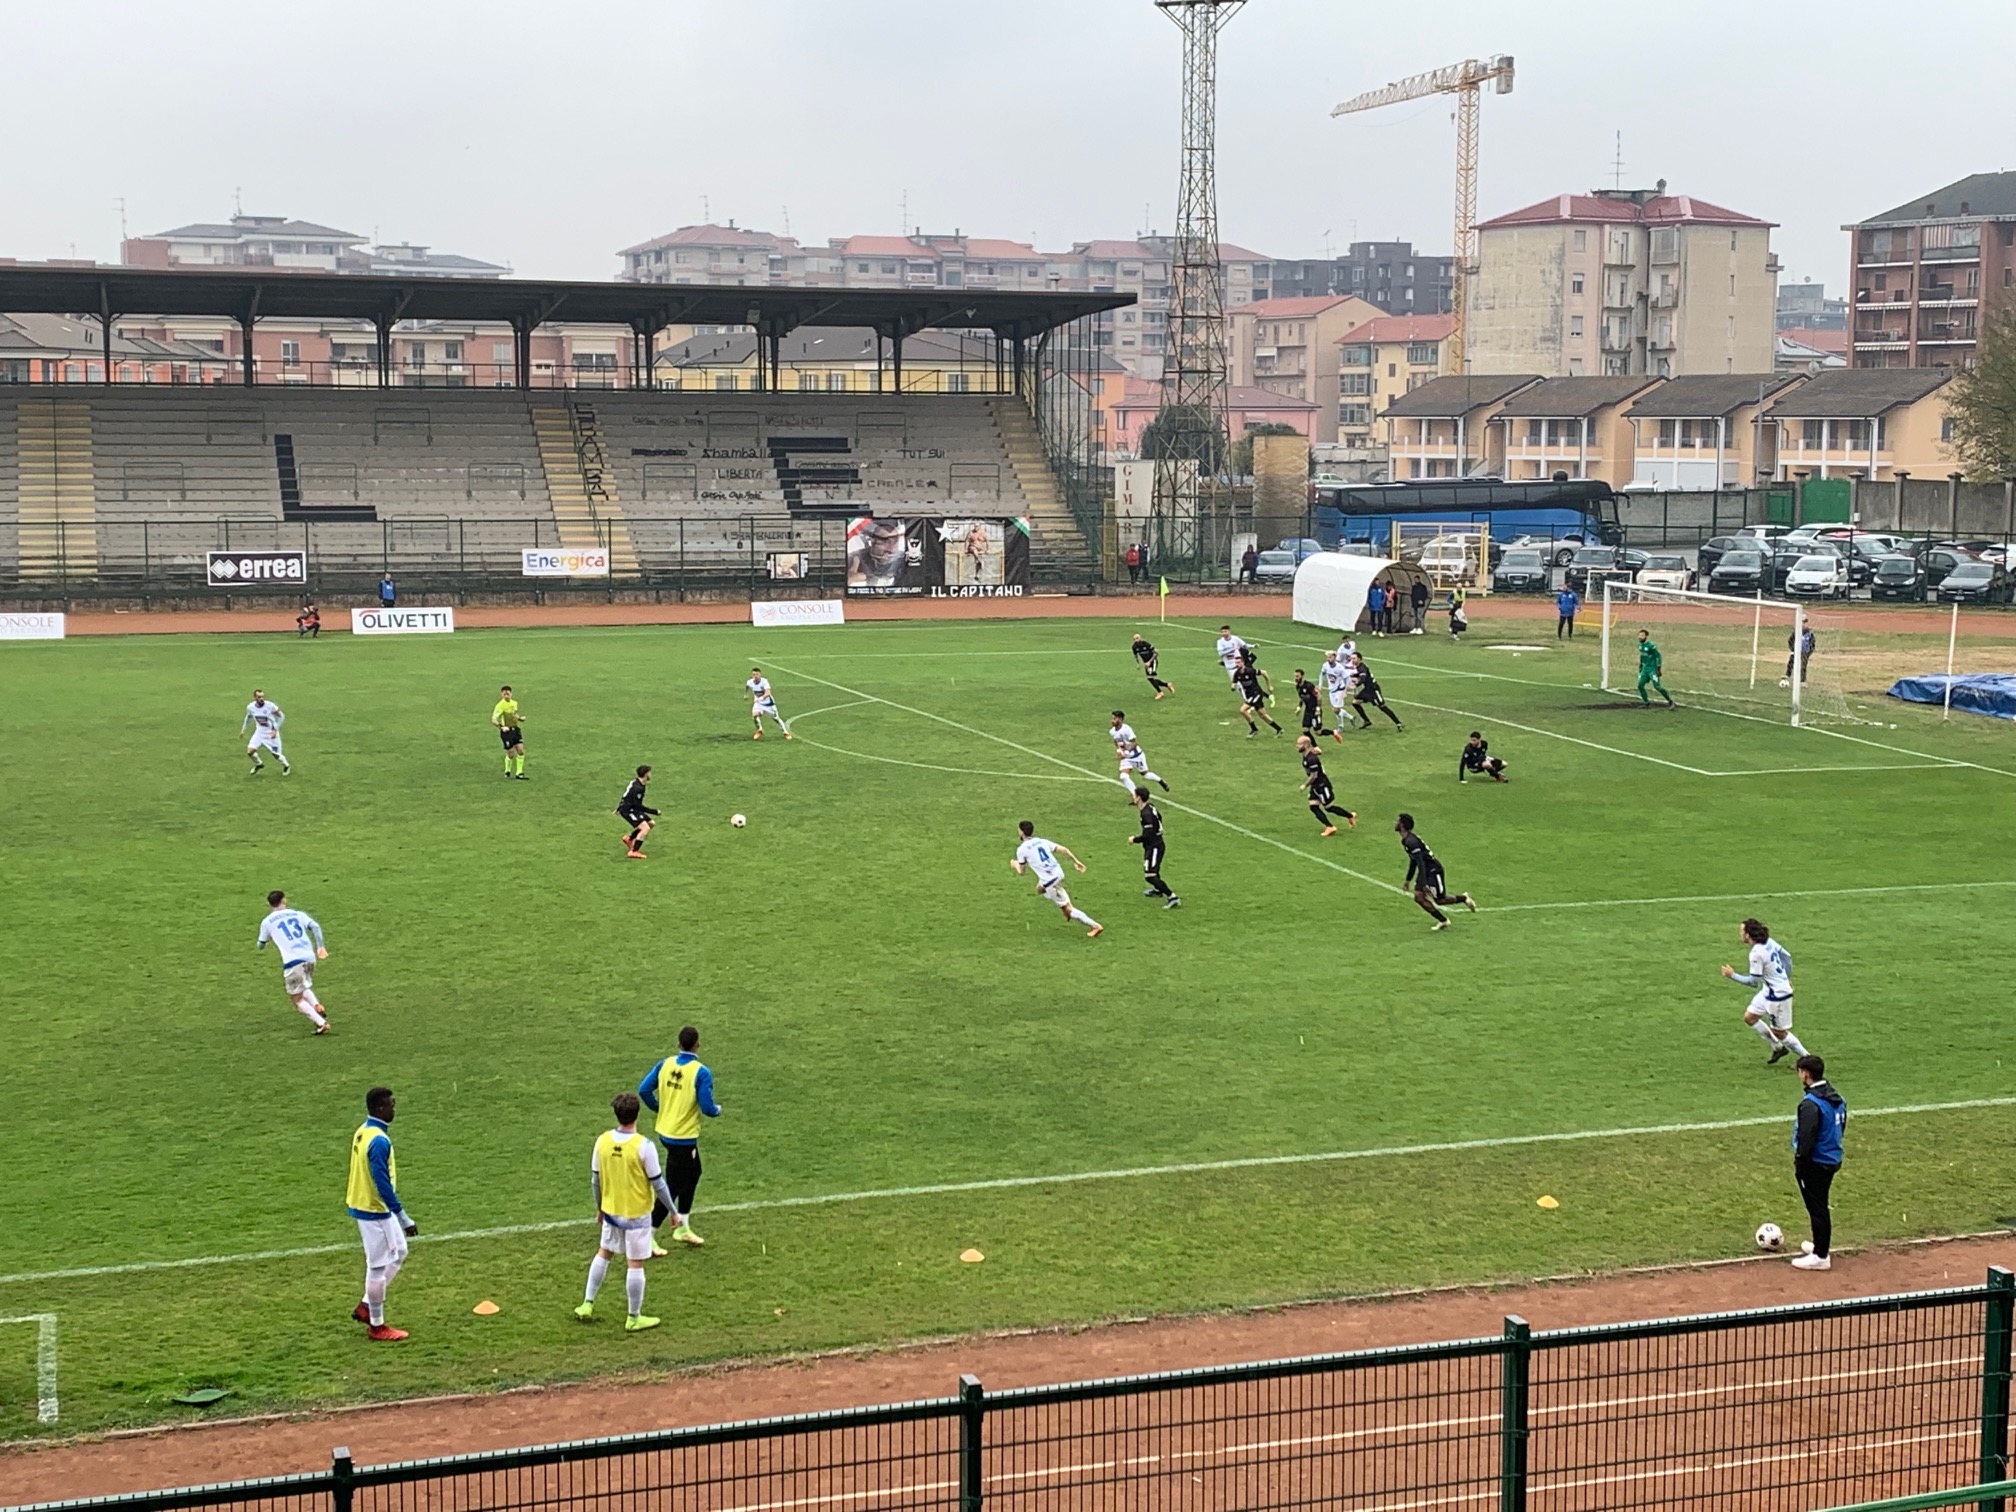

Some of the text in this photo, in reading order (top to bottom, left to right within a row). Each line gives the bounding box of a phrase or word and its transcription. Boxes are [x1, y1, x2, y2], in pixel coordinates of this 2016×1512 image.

[239, 558, 301, 578] errea
[526, 552, 605, 571] Energica
[930, 585, 947, 598] IL
[778, 603, 834, 615] CONSOLE
[362, 613, 447, 628] OLIVETTI
[1037, 846, 1051, 863] 4
[277, 917, 303, 941] 13
